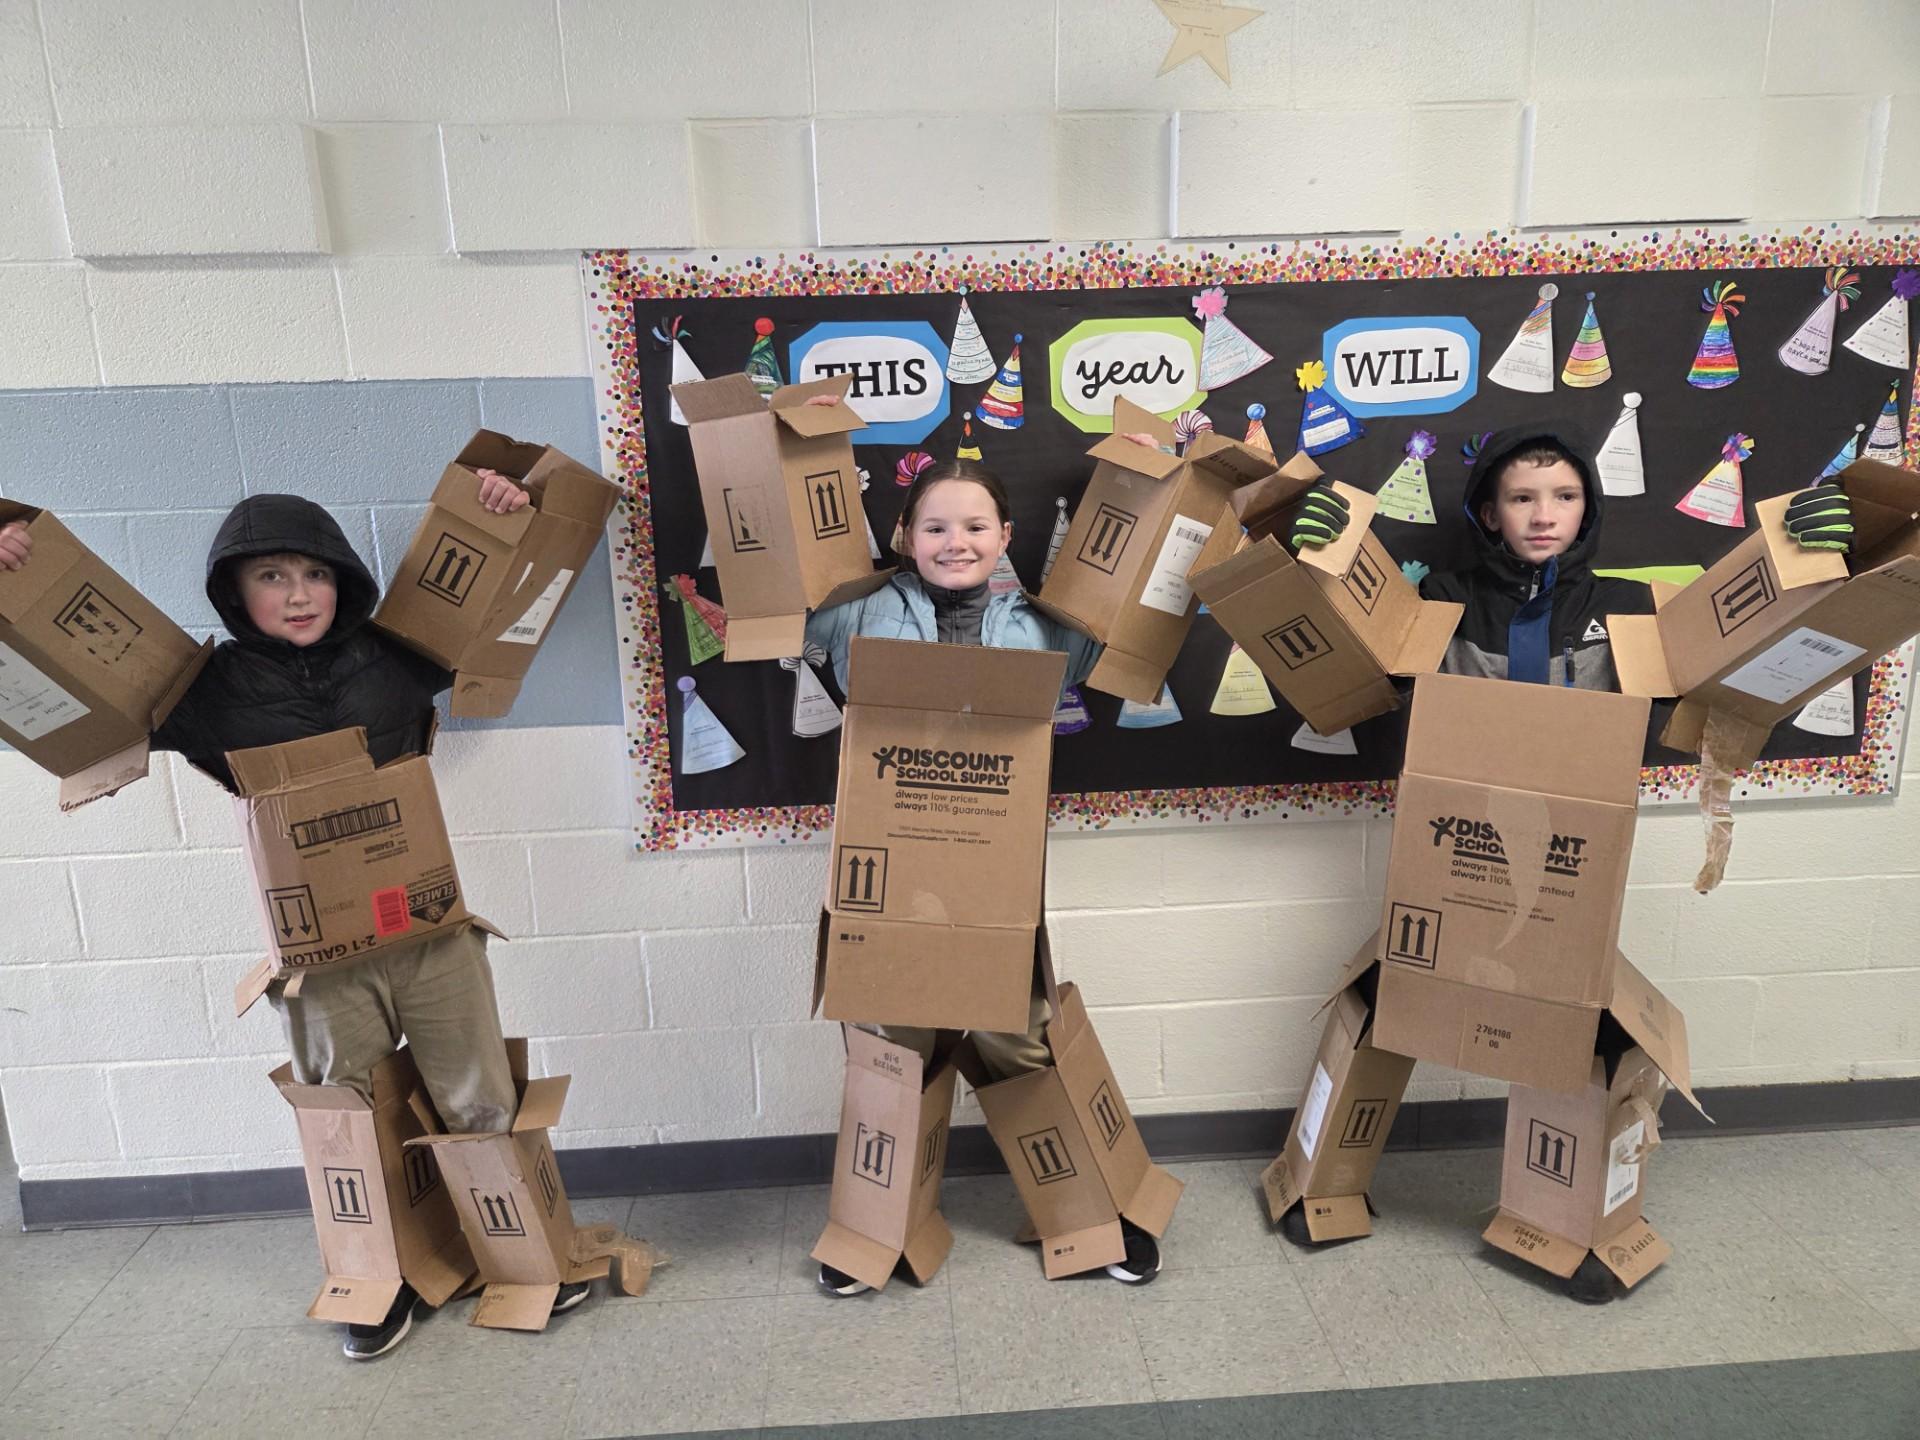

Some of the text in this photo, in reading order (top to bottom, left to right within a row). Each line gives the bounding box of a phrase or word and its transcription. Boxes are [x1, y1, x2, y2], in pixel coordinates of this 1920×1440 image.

[1076, 355, 1185, 399] year
[1341, 346, 1459, 388] WILL
[814, 358, 928, 398] THIS
[897, 747, 1014, 773] DISCOUNT
[896, 766, 1011, 787] SCHOOL SUPPLY
[895, 790, 978, 805] always low prices
[894, 801, 1007, 817] always 110% guaranteed
[1452, 858, 1509, 875] always low
[1451, 870, 1486, 882] always
[1489, 874, 1512, 887] 110%
[281, 945, 347, 967] GALLON
